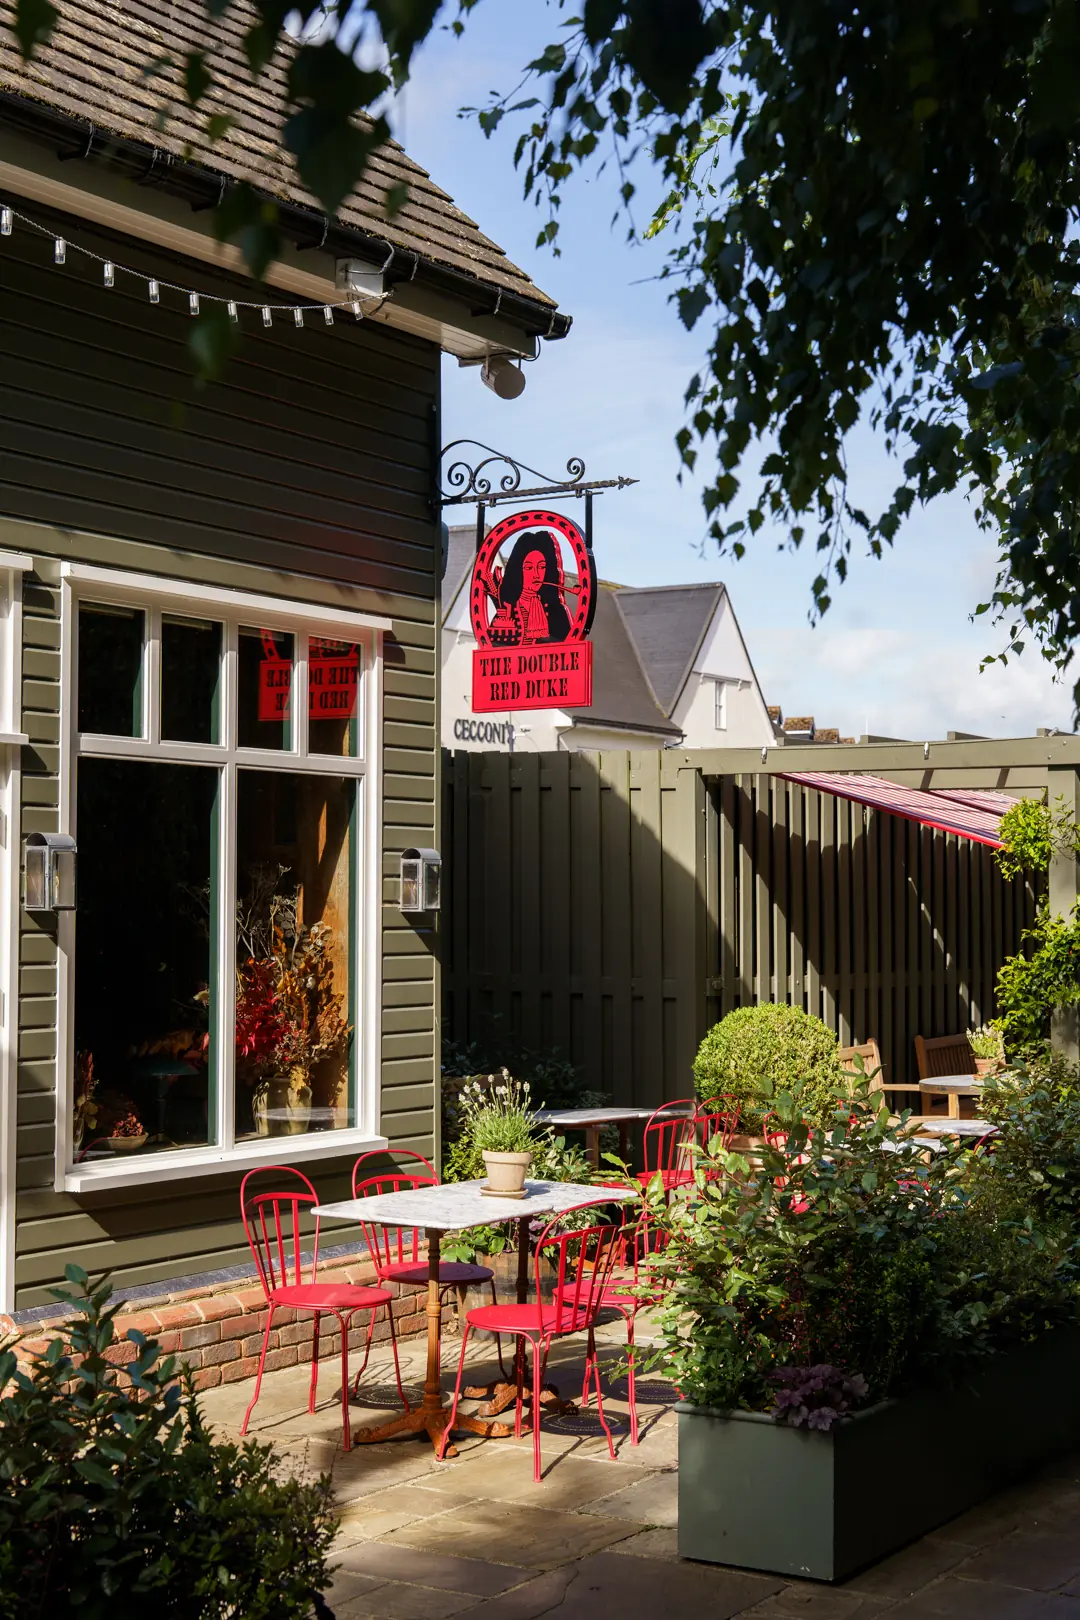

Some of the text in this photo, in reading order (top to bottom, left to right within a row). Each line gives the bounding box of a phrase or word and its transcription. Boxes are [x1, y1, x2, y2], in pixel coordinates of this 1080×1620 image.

[480, 651, 579, 676] THE DOUBLE
[490, 678, 568, 700] RED DUKE
